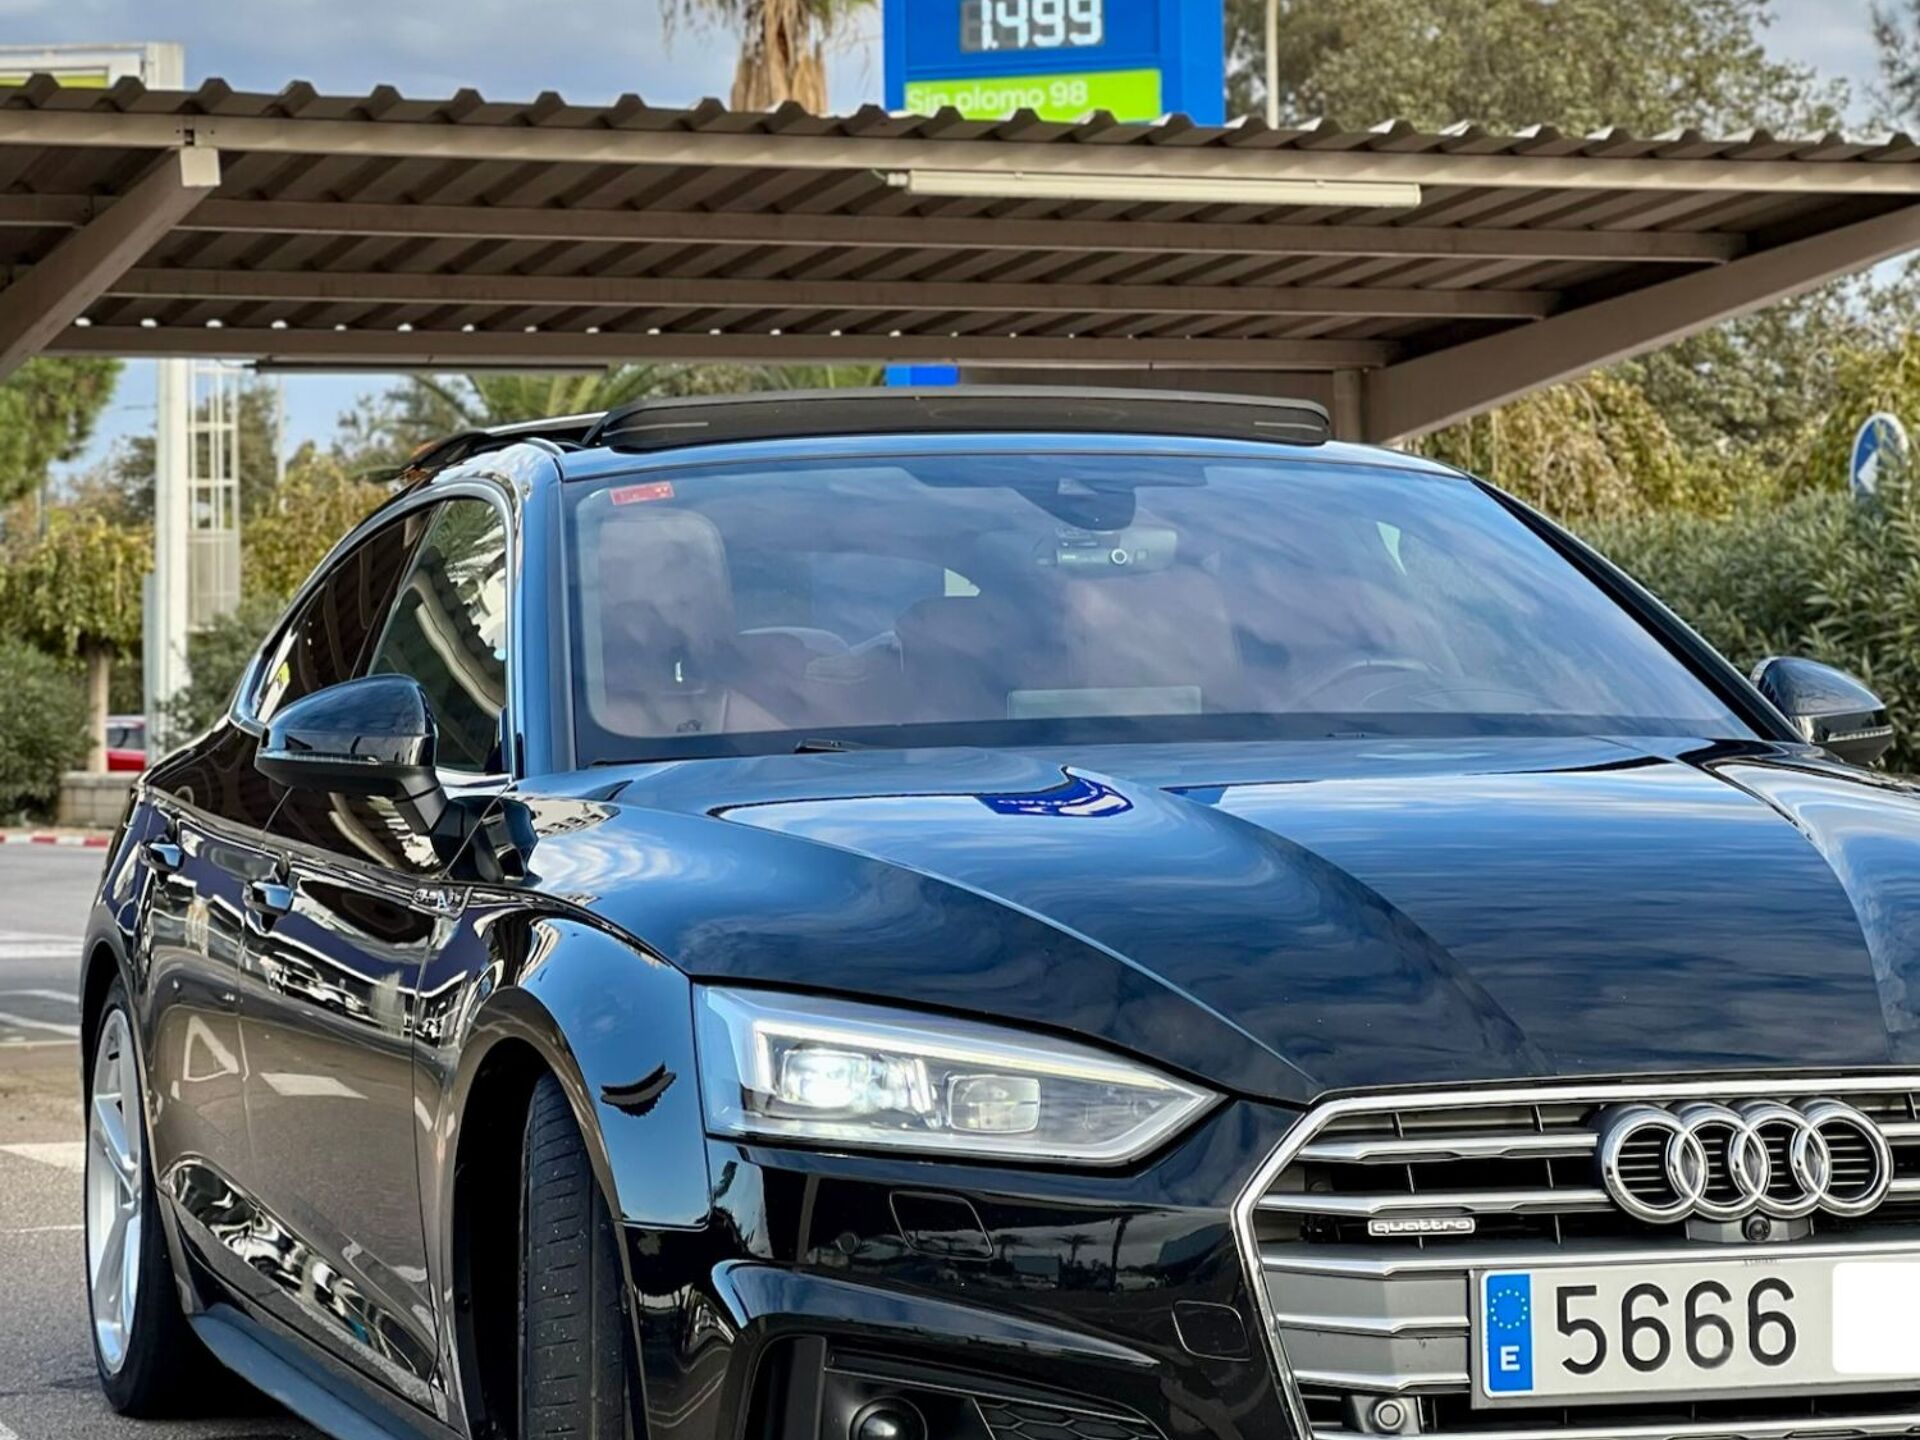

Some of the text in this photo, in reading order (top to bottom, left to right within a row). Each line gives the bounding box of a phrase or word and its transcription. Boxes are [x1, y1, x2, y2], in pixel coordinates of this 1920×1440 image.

[981, 0, 1102, 50] 1.499
[909, 86, 949, 114] Sin
[1050, 79, 1089, 108] 98
[1373, 1218, 1471, 1234] quattro
[1556, 1277, 1797, 1375] 5666
[1500, 1345, 1520, 1371] E
